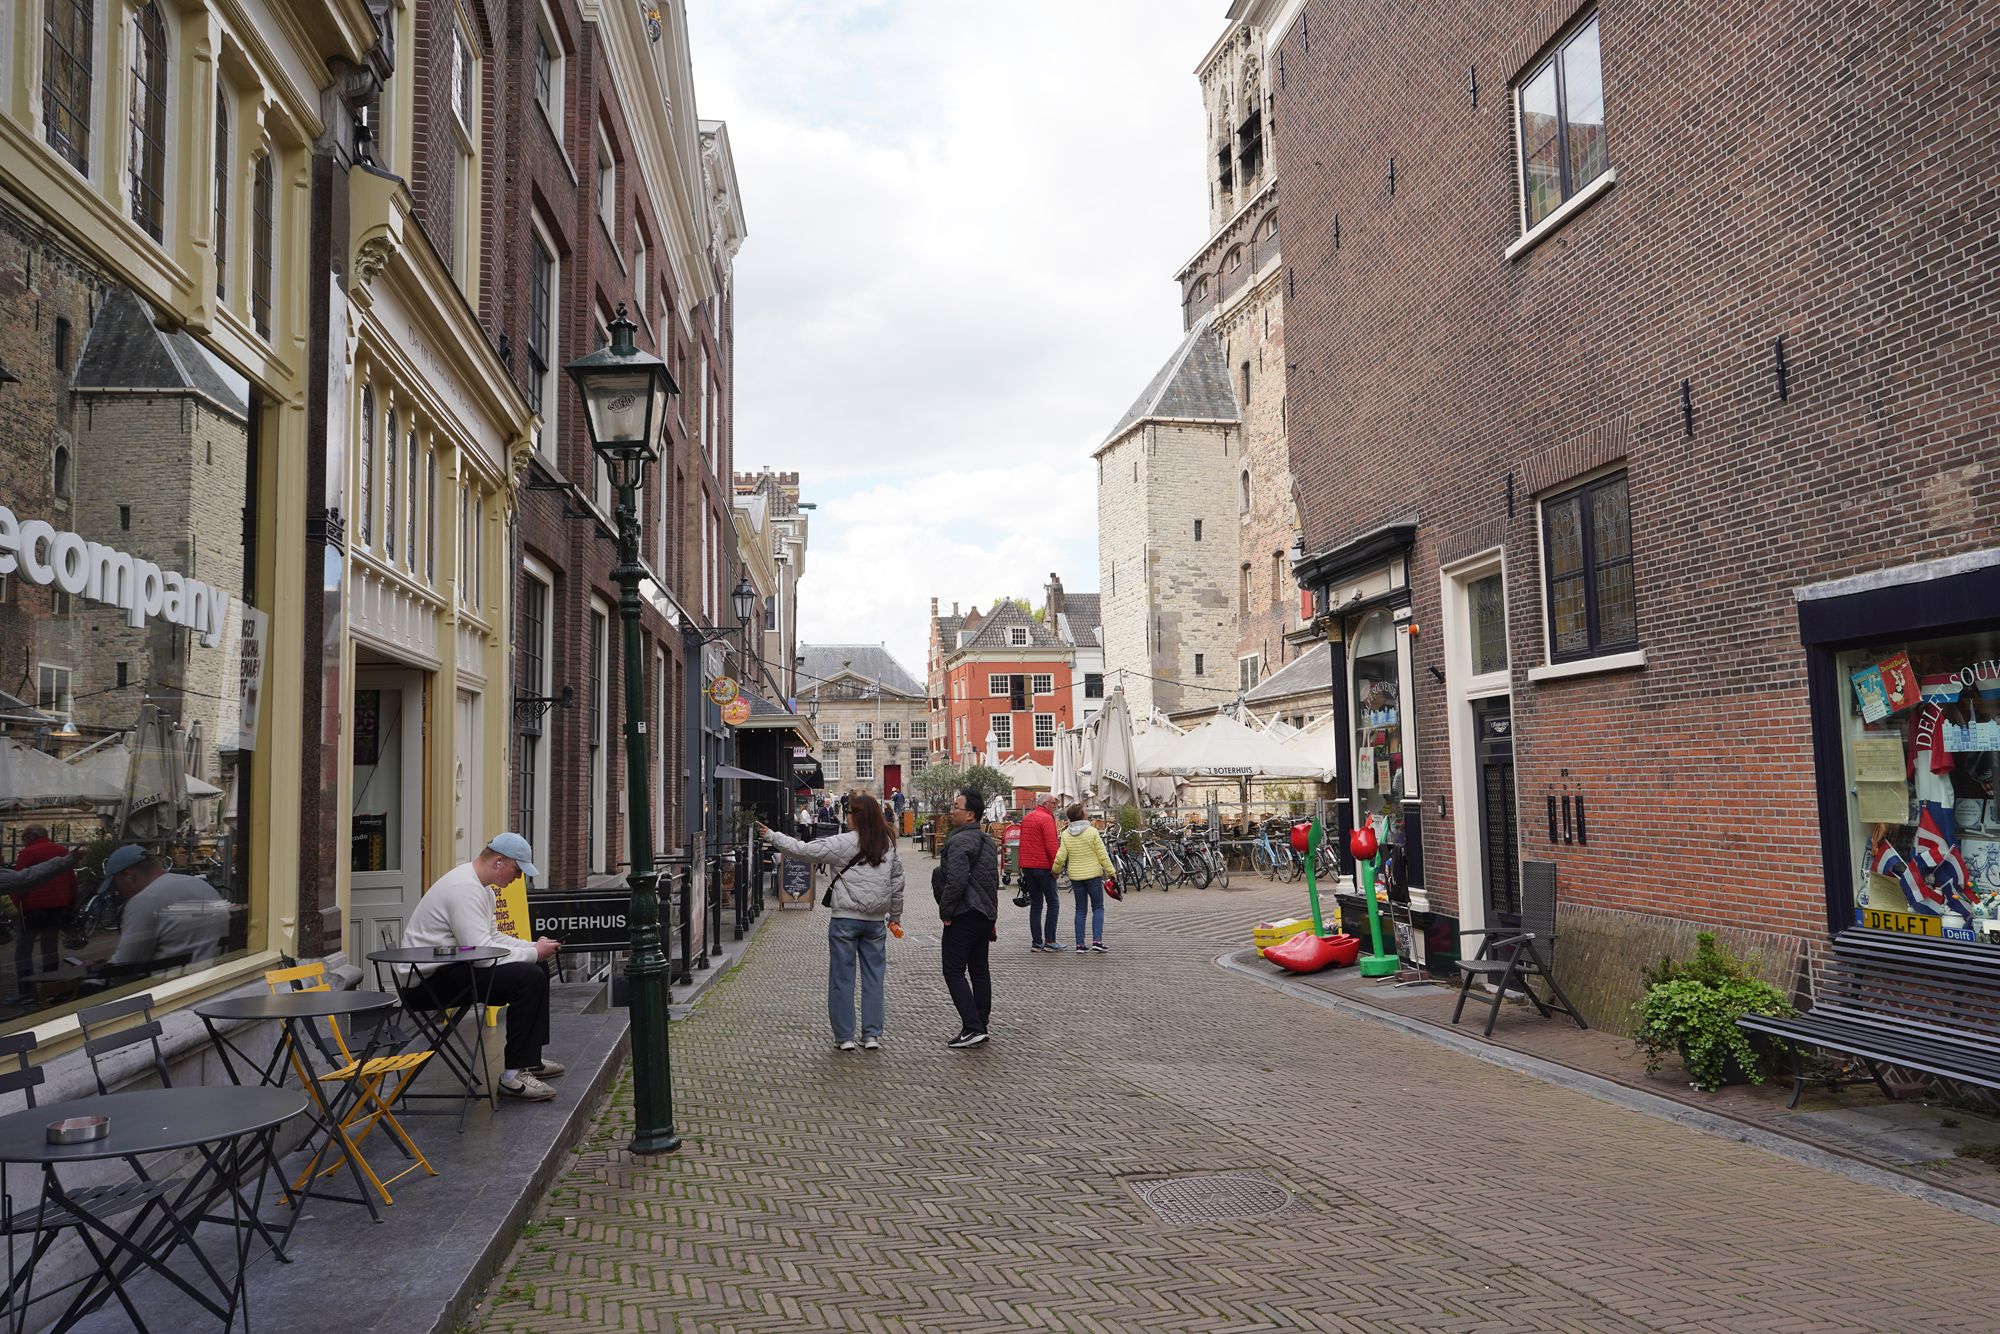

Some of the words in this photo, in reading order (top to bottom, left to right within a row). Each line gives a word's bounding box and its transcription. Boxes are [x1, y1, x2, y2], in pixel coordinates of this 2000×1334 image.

[1916, 684, 1952, 749] DELFT
[823, 740, 833, 750] de
[837, 740, 873, 749] centrale
[1213, 766, 1253, 775] BOTERHUIS
[535, 914, 627, 931] BOTERHUIS
[1871, 911, 1929, 935] DELFT
[1947, 929, 1971, 941] Delft
